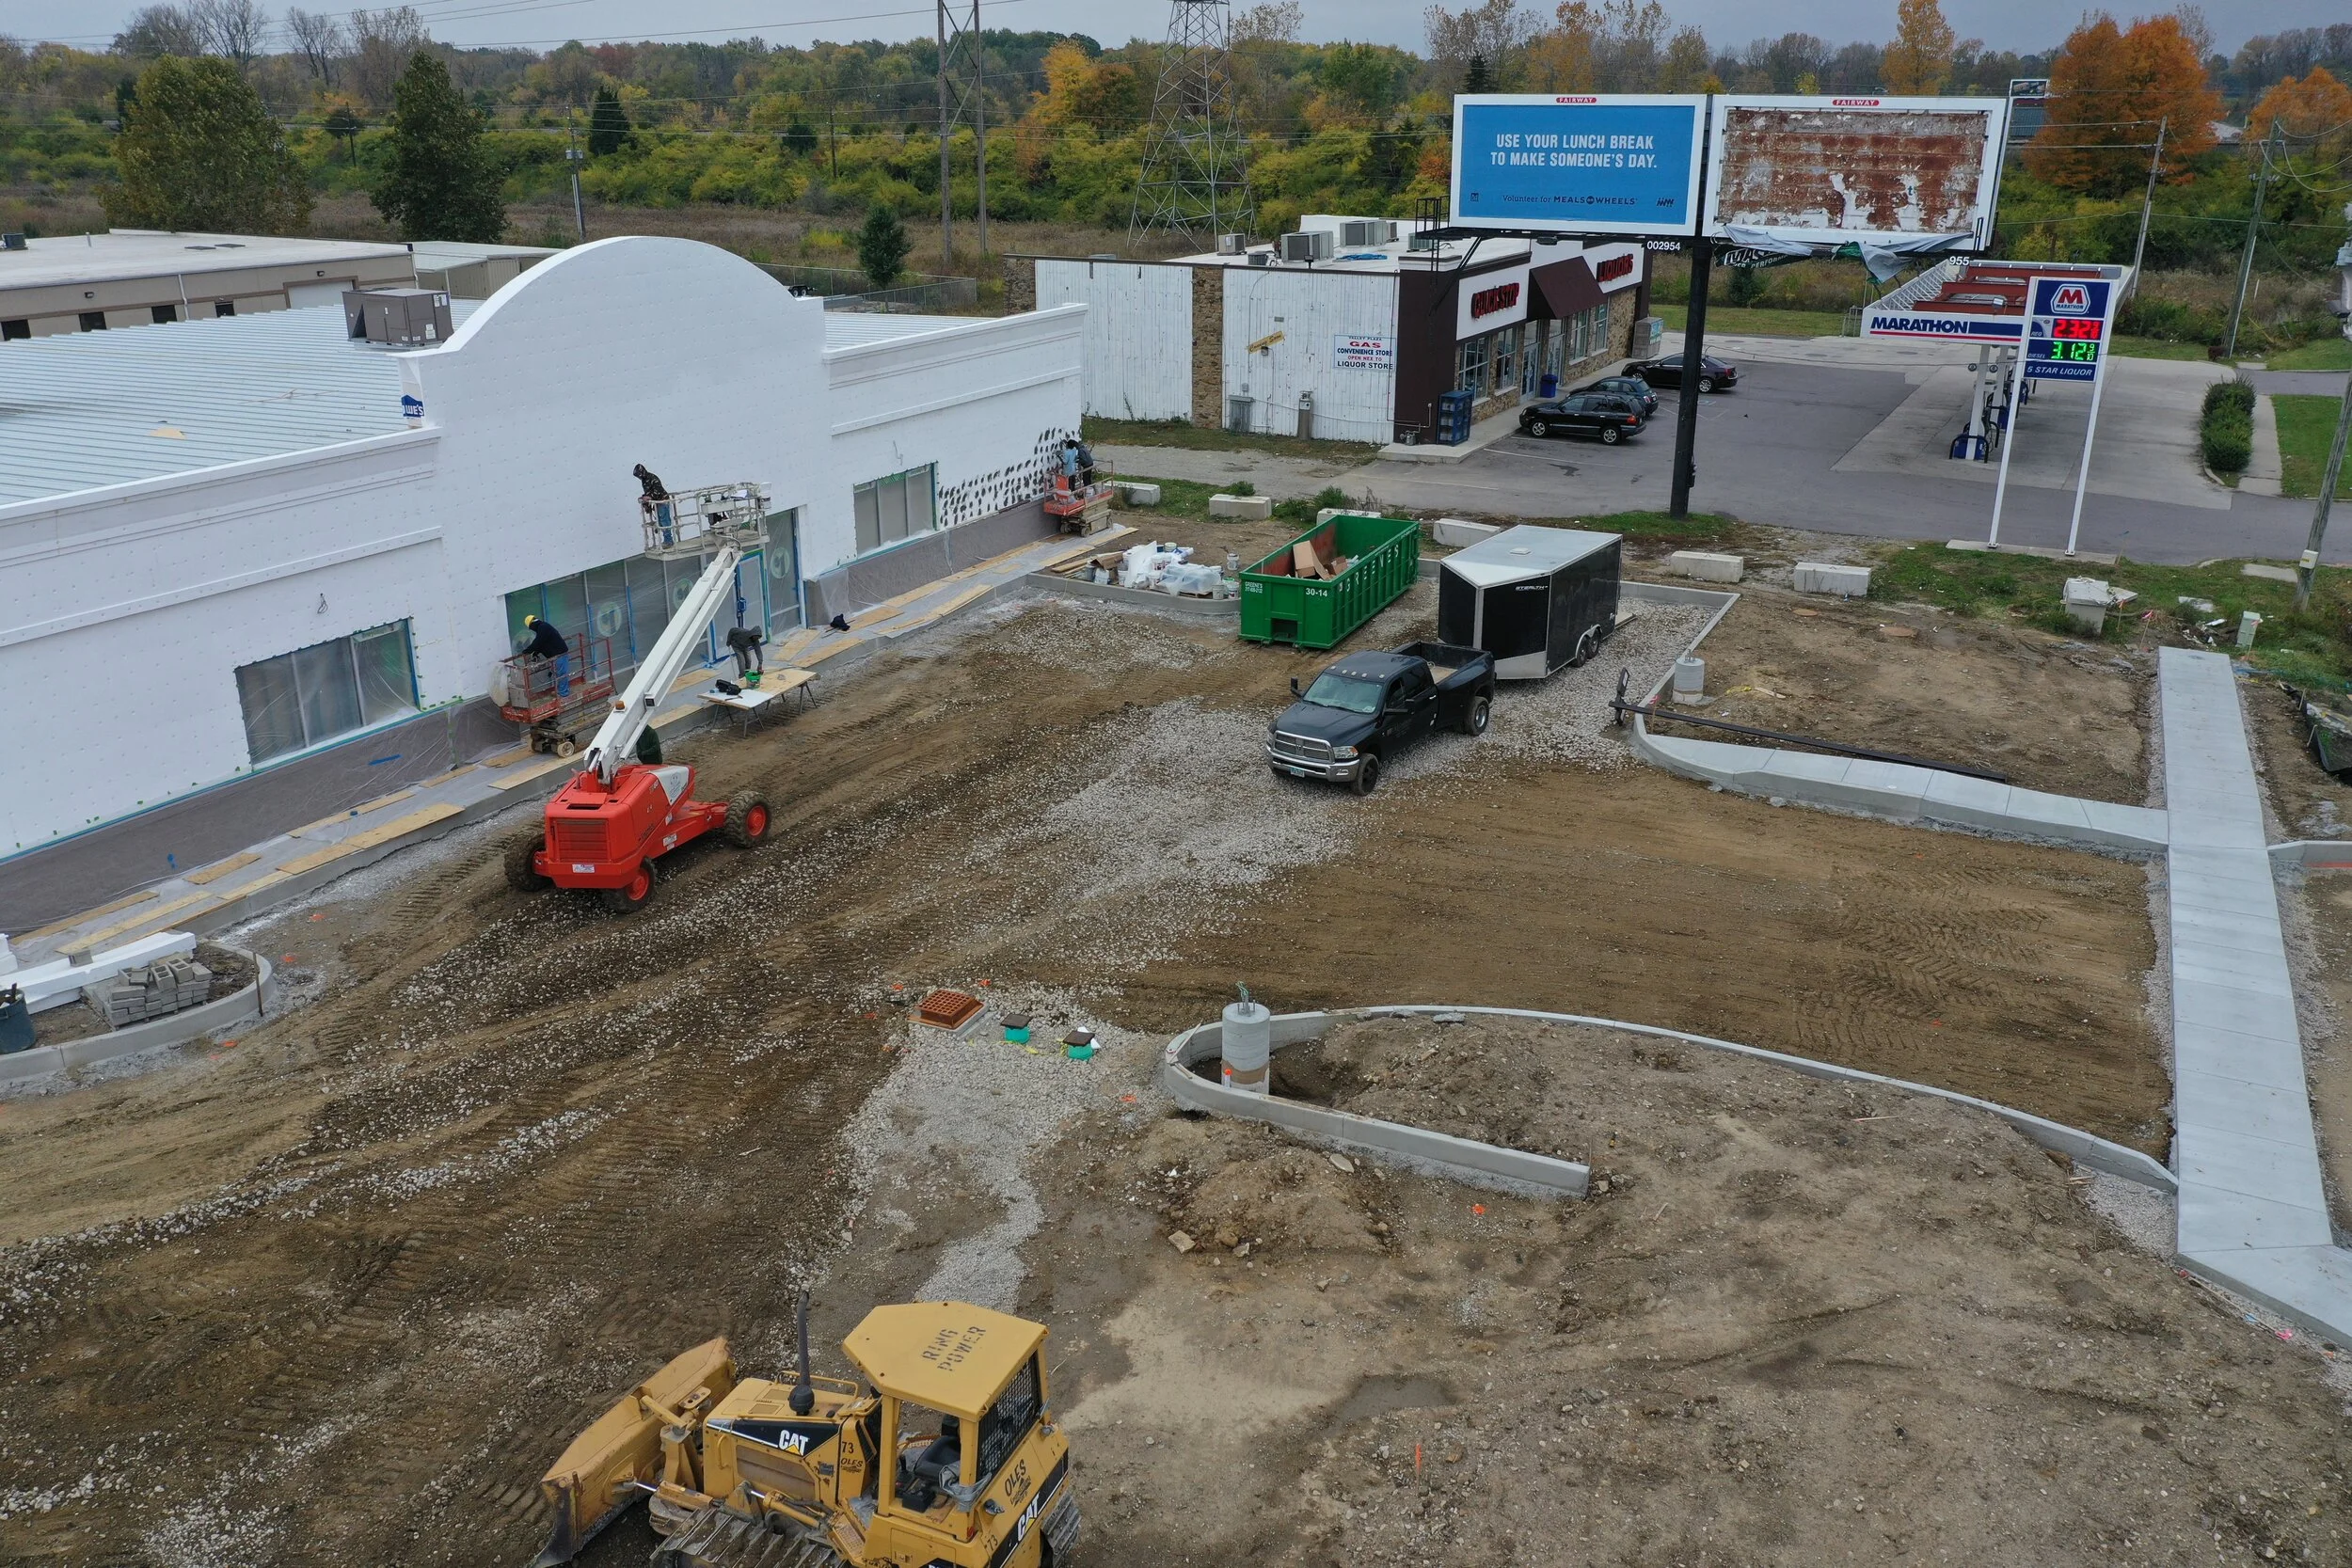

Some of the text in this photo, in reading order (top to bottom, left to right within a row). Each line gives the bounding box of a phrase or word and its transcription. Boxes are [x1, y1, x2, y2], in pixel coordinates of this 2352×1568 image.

[1497, 134, 1654, 150] USE YOUR LUNCH BREAK
[1490, 151, 1657, 168] TO MAKE SOMEONE'S DAY.
[1553, 196, 1585, 204] MEALS
[1596, 197, 1635, 205] WHEELS
[1646, 240, 1681, 251] 002954
[1596, 253, 1633, 282] LIQUORS
[1949, 255, 1970, 266] 955
[2058, 289, 2083, 304] M
[1870, 316, 1968, 334] MARATHON
[2035, 366, 2058, 374] STAR
[1306, 587, 1327, 596] 30-14
[922, 1329, 959, 1360] RING
[937, 1326, 986, 1371] POWER
[778, 1430, 808, 1456] CAT
[842, 1442, 854, 1454] 73
[1004, 1459, 1026, 1497] OLES
[1017, 1491, 1040, 1542] CAT
